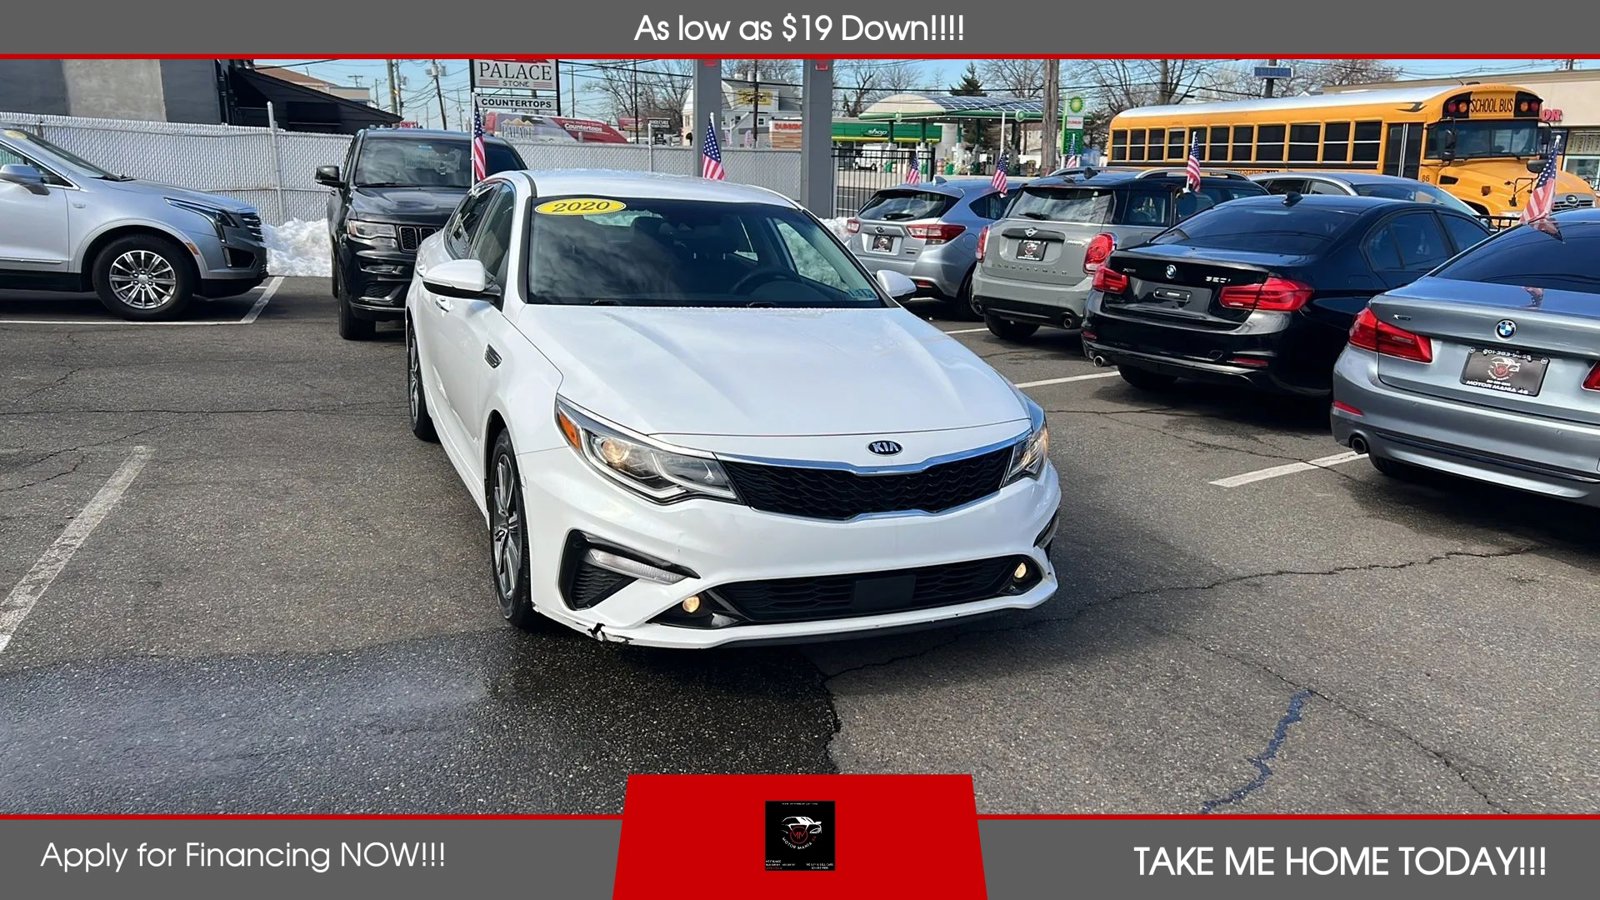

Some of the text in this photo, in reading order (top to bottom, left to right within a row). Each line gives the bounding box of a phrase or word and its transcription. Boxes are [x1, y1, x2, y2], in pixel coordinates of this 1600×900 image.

[479, 62, 552, 80] PALACE
[481, 98, 552, 108] COUNTERTOPS
[1470, 98, 1514, 113] SCHOOL BUS
[868, 128, 888, 136] shop
[552, 201, 611, 213] 2020
[1466, 380, 1492, 388] MOTOR
[872, 442, 899, 453] KIA
